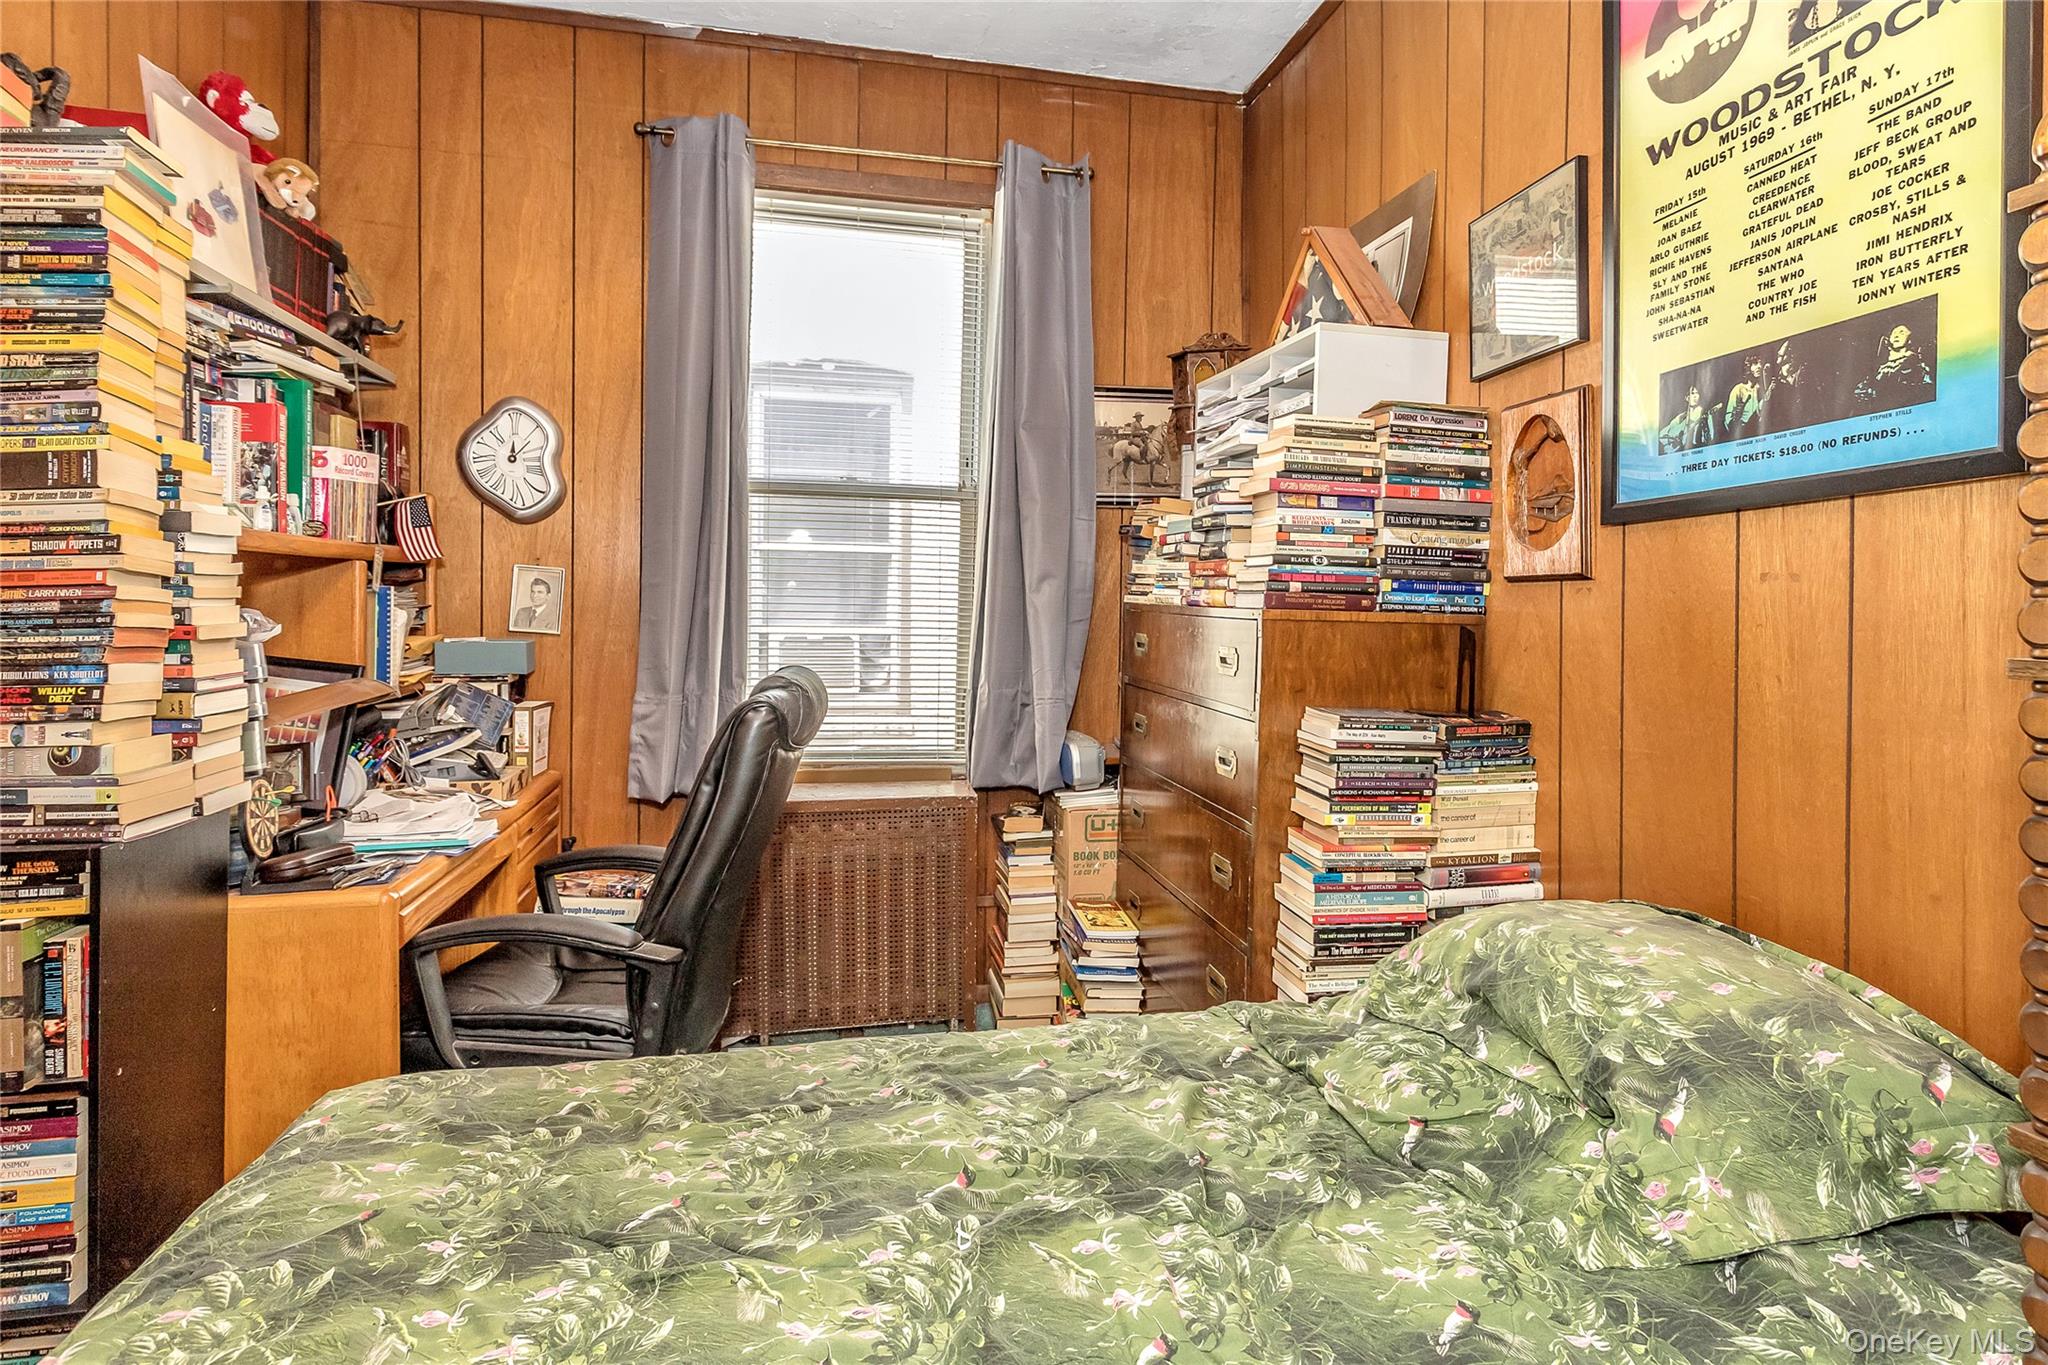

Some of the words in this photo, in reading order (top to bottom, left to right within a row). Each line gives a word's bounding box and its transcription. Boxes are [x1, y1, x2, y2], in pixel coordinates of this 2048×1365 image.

[1868, 82, 1919, 115] SUNDAY
[1926, 67, 1955, 87] 17th
[1719, 117, 1761, 146] MUSIC
[1768, 108, 1778, 121] &
[1784, 88, 1813, 113] ART
[1821, 65, 1857, 94] FAIR
[1876, 116, 1900, 133] THE
[1906, 96, 1942, 120] BAND
[1685, 146, 1735, 180] AUGUST
[1742, 127, 1775, 153] 1969
[1793, 89, 1856, 126] BETHEL,
[1861, 76, 1877, 93] N.
[1884, 63, 1901, 79] Y.
[1854, 142, 1880, 161] JEFF
[1886, 124, 1919, 146] BECK
[1925, 100, 1972, 128] GROUP
[1743, 143, 1795, 175] SATURDAY
[1800, 131, 1823, 149] 16th
[1849, 156, 1892, 180] BLOOD,
[1898, 132, 1943, 158] SWEAT
[1948, 117, 1977, 137] AND
[1746, 170, 1786, 193] CANNED
[1790, 154, 1817, 174] HEAT
[1886, 154, 1926, 178] TEARS
[1752, 173, 1811, 205] CREEDENCE
[1871, 185, 1892, 201] JOE
[1898, 162, 1950, 190] COCKER
[1654, 196, 1684, 216] FRIDAY
[1687, 186, 1706, 201] 15th
[1748, 185, 1815, 220] CLEARWATER
[1849, 200, 1900, 226] CROSBY,
[1906, 180, 1950, 205] STILLS
[1956, 174, 1967, 185] &
[1661, 208, 1698, 231] MELANIE
[1742, 211, 1791, 237] GRATEFUL
[1796, 197, 1824, 215] DEAD
[1892, 204, 1926, 225] NASH
[1657, 232, 1677, 247] JOAN
[1680, 221, 1702, 238] BAEZ
[1750, 232, 1777, 249] JANIS
[1781, 216, 1816, 237] JOPLIN
[1866, 234, 1890, 251] JIMI
[1896, 211, 1953, 241] HENDRIX
[23, 256, 59, 264] FANTASTIC
[61, 255, 86, 263] VOYAGE
[1649, 249, 1670, 265] ARLO
[1673, 232, 1710, 254] GUTHRIE
[1729, 246, 1781, 273] JEFFERSON
[1786, 223, 1839, 251] AIRPLANE
[1856, 254, 1883, 271] IRON
[1889, 226, 1963, 260] BUTTERFLY
[1649, 260, 1676, 278] RICHIE
[1679, 245, 1712, 266] HAVENS
[1757, 253, 1804, 277] SANTANA
[1852, 274, 1874, 289] TEN
[1880, 259, 1920, 280] YEARS
[1926, 243, 1969, 265] AFTER
[1650, 285, 1680, 303] FAMILY
[1683, 272, 1711, 290] STONE
[1652, 277, 1668, 290] SLY
[1670, 270, 1688, 283] AND
[1691, 261, 1708, 275] THE
[1757, 278, 1776, 292] THE
[1780, 268, 1805, 284] WHO
[1857, 284, 1896, 304] JONNY
[1902, 264, 1961, 290] WINTERS
[1646, 303, 1666, 318] JOHN
[1669, 285, 1716, 309] SEBASTIAN
[1748, 287, 1794, 310] COUNTRY
[1799, 280, 1818, 293] JOE
[1658, 305, 1702, 327] SHA-NA-NA
[1745, 310, 1765, 324] AND
[1770, 302, 1789, 316] THE
[1793, 293, 1817, 308] FISH
[1652, 316, 1709, 343] SWEETWATER
[1394, 412, 1418, 421] LORENZ
[1430, 416, 1464, 425] Aggression
[37, 438, 54, 446] ALAN
[55, 438, 71, 446] DEAN
[72, 437, 96, 445] FOSTER
[1680, 461, 1708, 474] THREE
[1711, 457, 1729, 469] DAY
[1733, 450, 1775, 465] TICKETS:
[1779, 442, 1814, 457] $18.00
[1817, 438, 1838, 452] (NO
[1842, 427, 1902, 447] REFUNDS)
[334, 466, 354, 476] Record
[355, 469, 375, 479] Covers
[343, 454, 368, 468] 1000
[1425, 463, 1455, 472] Conscious
[279, 461, 287, 501] INVASION
[18, 492, 35, 500] short
[35, 492, 58, 500] science
[60, 491, 77, 499] fiction
[79, 491, 93, 499] tales
[1386, 516, 1411, 525] FRAMES
[1412, 517, 1420, 525] OF
[1421, 518, 1437, 526] MIND
[31, 540, 66, 550] SHADOW
[69, 540, 103, 549] PUPPETS
[1387, 546, 1414, 555] SPARKS
[1417, 547, 1425, 555] OF
[1428, 548, 1453, 556] GENIUS
[29, 589, 56, 597] LARRY
[56, 589, 82, 597] NIVEN
[0, 671, 49, 679] TRIBULATIONS
[53, 671, 68, 679] KEN
[37, 687, 77, 695] WILLIAM
[49, 695, 72, 703] DIETZ
[1073, 852, 1100, 861] BOOK
[1448, 856, 1496, 865] KYBALION
[12, 866, 59, 875] THEMSELVES
[18, 888, 38, 897] ISAAC
[39, 887, 64, 896] ASIMOV
[592, 907, 625, 916] Apocalypse
[1354, 946, 1364, 954] Mars
[44, 978, 62, 1015] LOVECRAFT
[45, 1057, 54, 1075] DEATH
[55, 1048, 64, 1075] SHADOWS
[0, 1124, 32, 1133] ASIMOV
[0, 1143, 32, 1151] ASIMOV
[1, 1161, 31, 1169] ASIMOV
[8, 1168, 57, 1178] FOUNDATION
[19, 1208, 68, 1216] FOUNDATION
[2, 1225, 37, 1234] ASIMOV
[17, 1292, 49, 1303] ASIMOV
